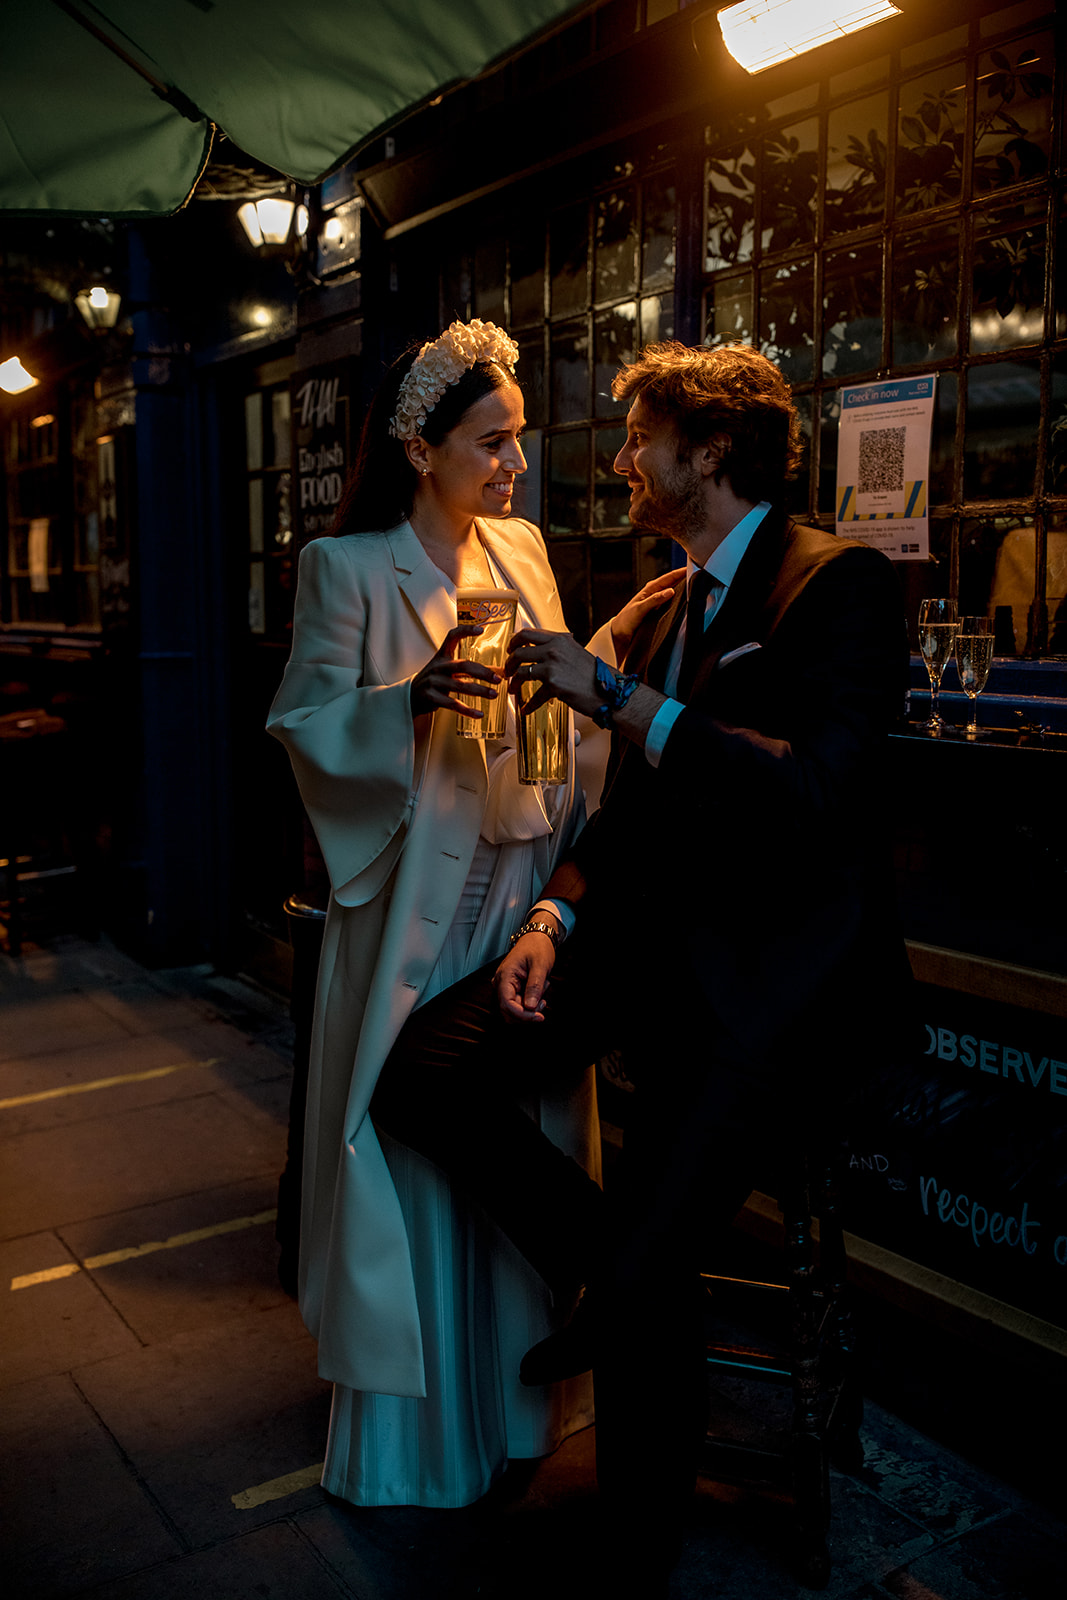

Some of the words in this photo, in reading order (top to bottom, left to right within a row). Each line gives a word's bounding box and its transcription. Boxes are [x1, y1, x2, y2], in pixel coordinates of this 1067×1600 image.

[847, 391, 870, 404] Check
[871, 390, 879, 400] in
[880, 389, 900, 400] now
[298, 441, 344, 475] English
[299, 472, 343, 510] FOOD
[469, 599, 515, 622] Beer
[848, 1153, 889, 1172] AND
[919, 1175, 1041, 1256] respect
